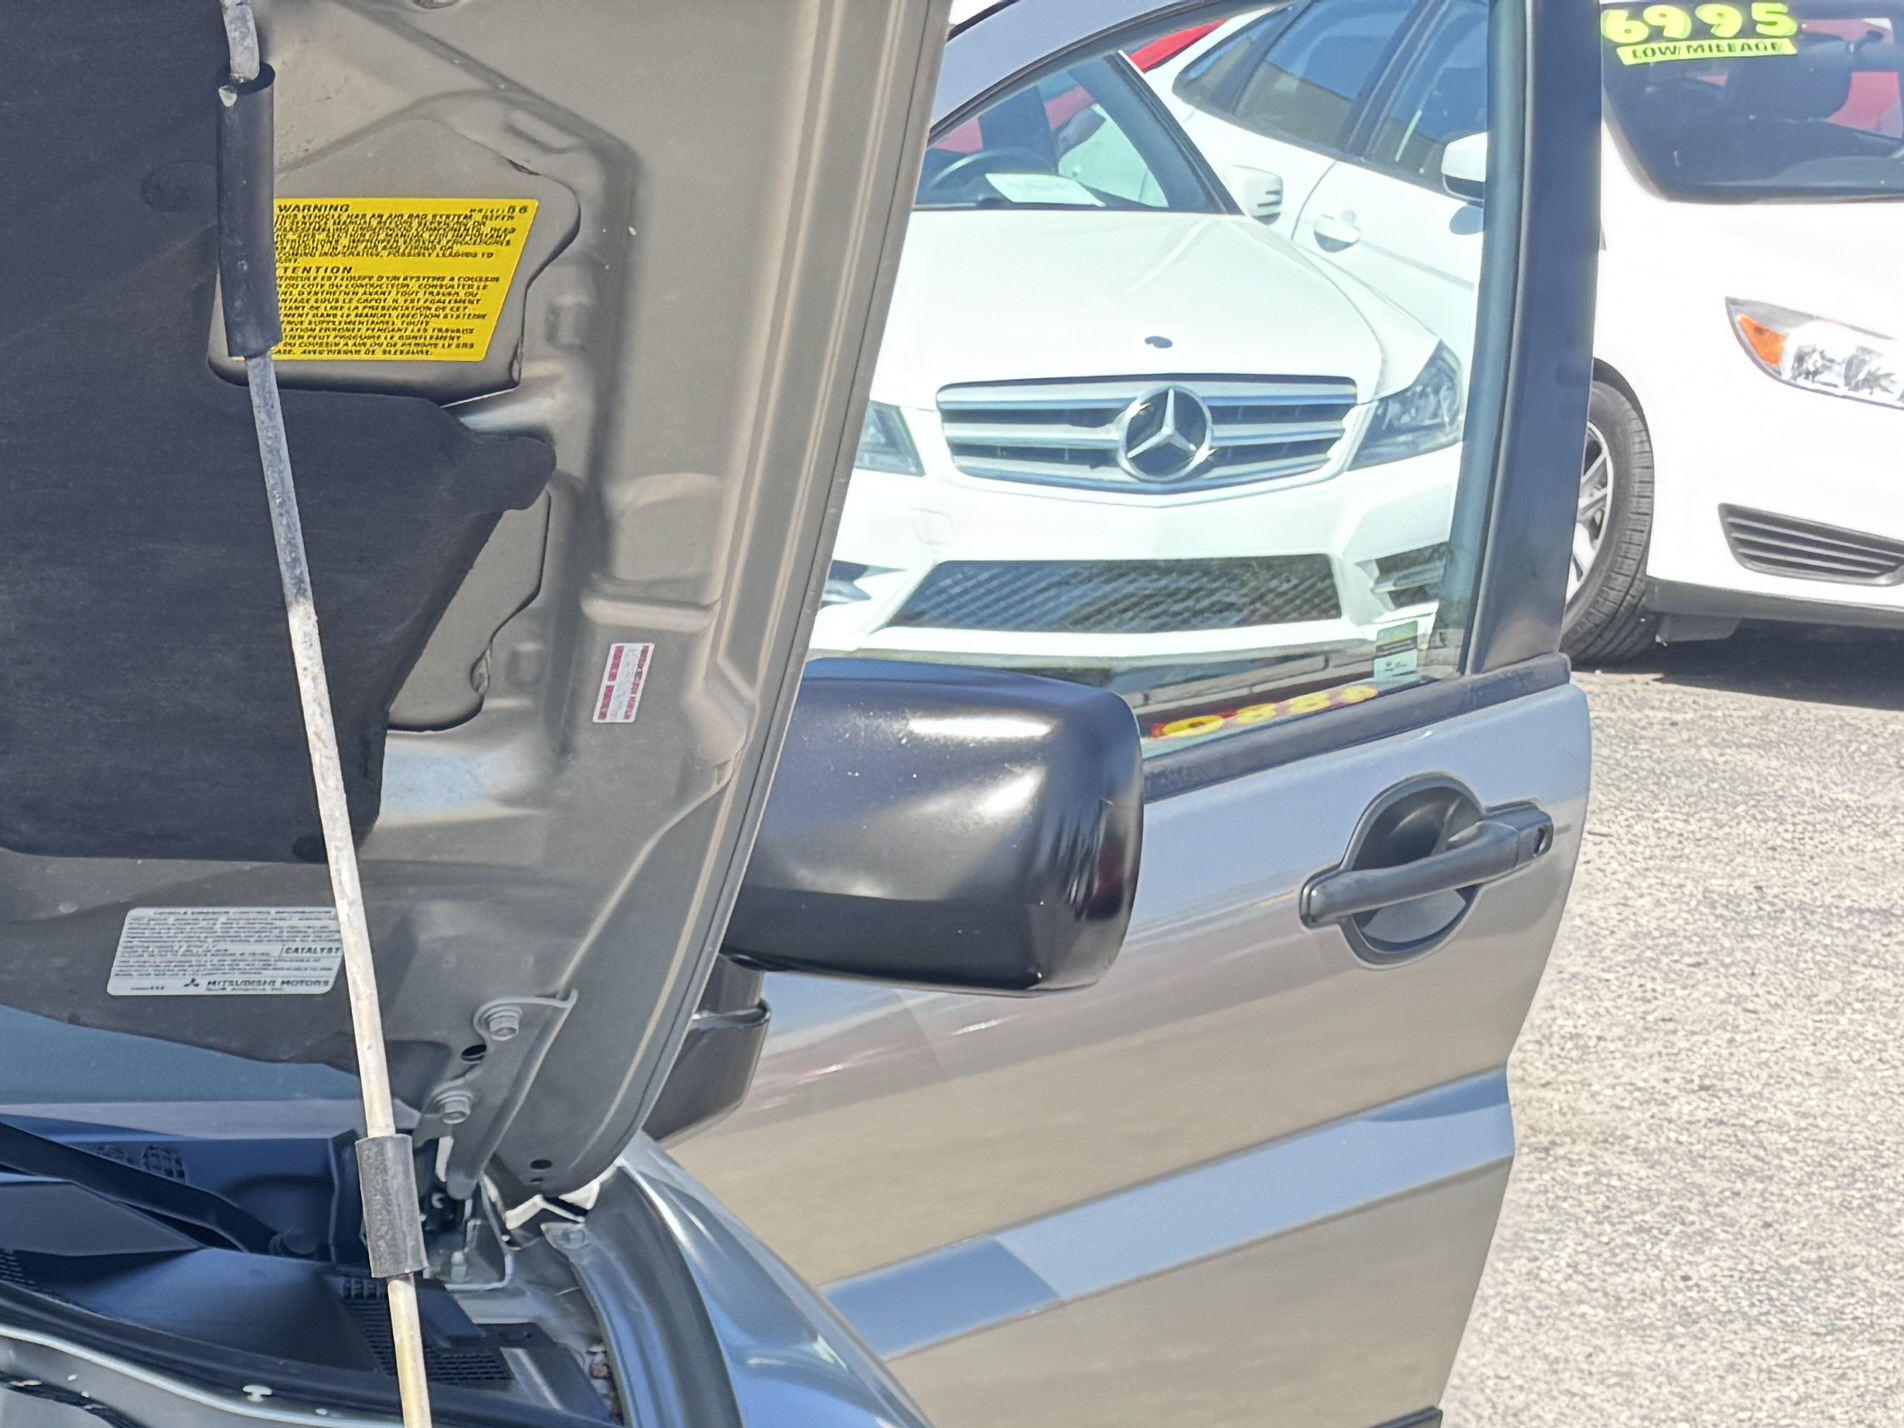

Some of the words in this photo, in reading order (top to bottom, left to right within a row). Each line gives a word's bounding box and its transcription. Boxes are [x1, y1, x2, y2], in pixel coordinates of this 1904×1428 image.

[1600, 2, 1797, 43] 6995
[1631, 44, 1680, 59] LOW
[1685, 41, 1784, 54] MILEAGE
[278, 204, 350, 213] WARNING
[283, 266, 352, 274] TENTION
